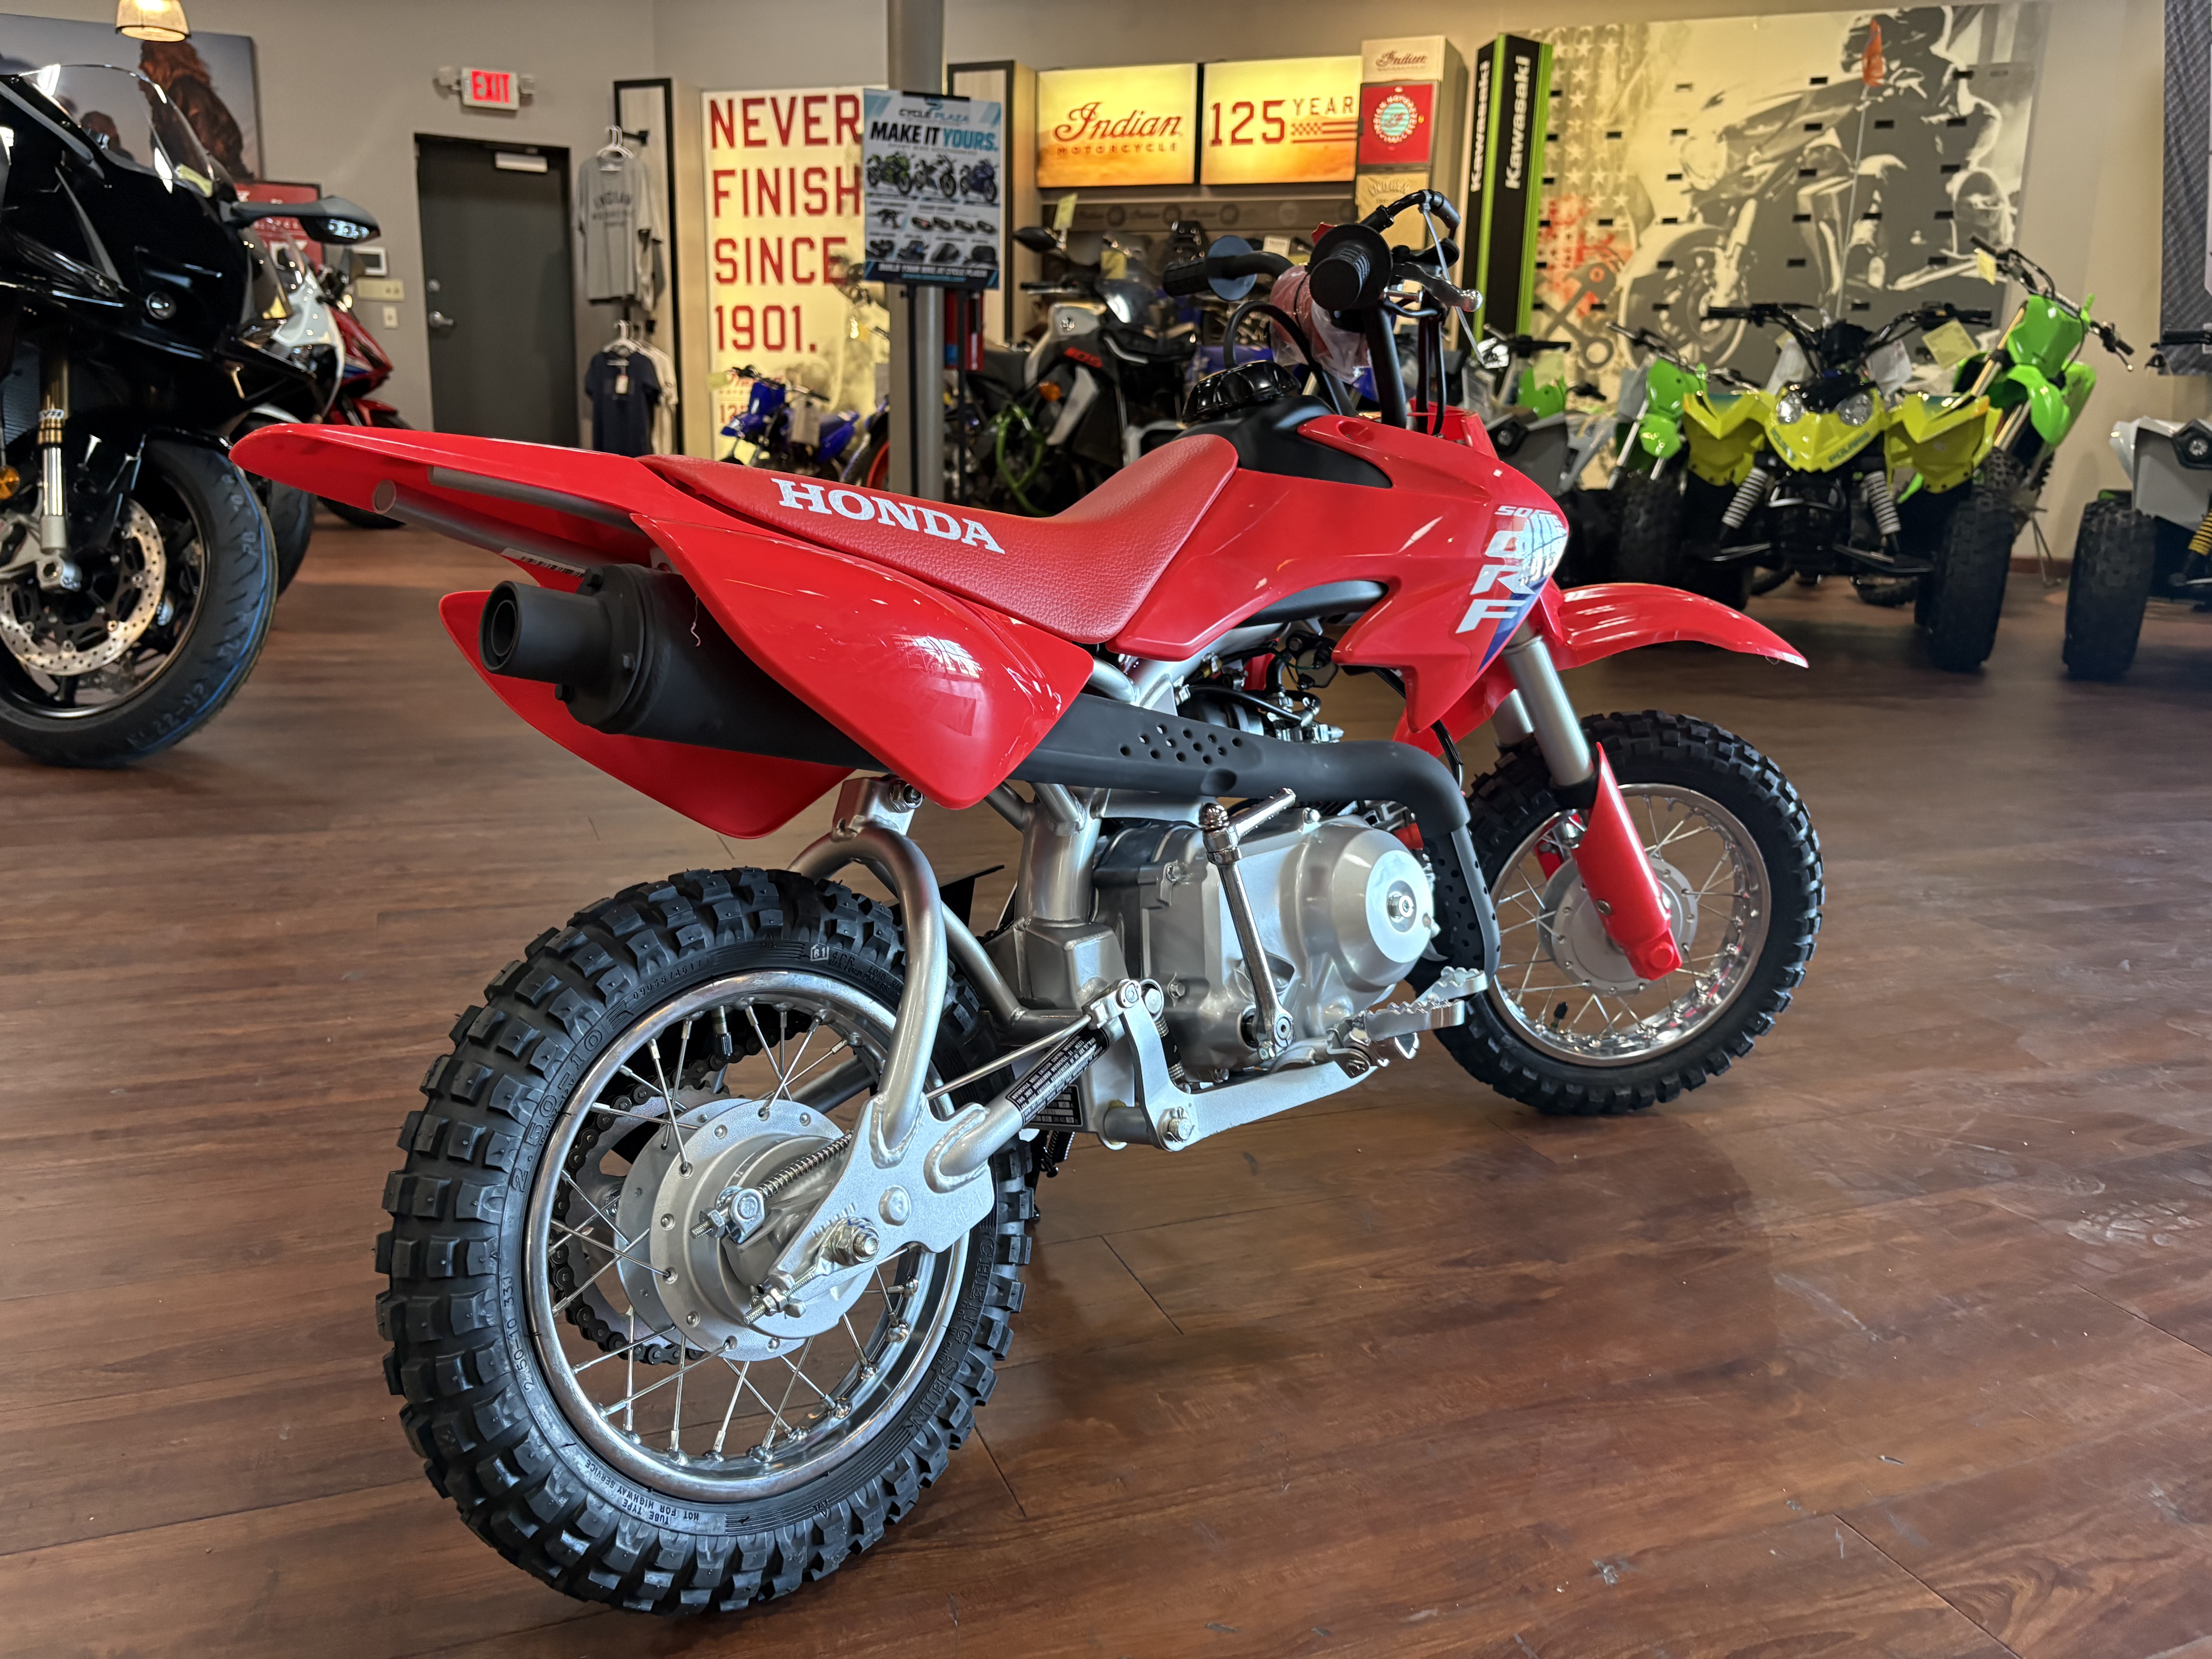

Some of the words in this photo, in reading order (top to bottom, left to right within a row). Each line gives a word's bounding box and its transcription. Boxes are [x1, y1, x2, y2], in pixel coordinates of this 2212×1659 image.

[471, 70, 511, 104] EXIT
[710, 94, 861, 149] NEVER
[898, 108, 931, 118] CYCLE
[1054, 101, 1183, 143] Indian
[1210, 100, 1286, 147] 125
[1293, 96, 1354, 116] YEAR
[1470, 59, 1491, 193] Kawasaki
[1506, 55, 1531, 189] Kawasaki
[870, 122, 923, 144] MAKE
[924, 126, 940, 145] IT
[943, 128, 999, 152] YOURS.
[1057, 142, 1178, 156] MOTORCYCLE
[715, 237, 848, 286] SINCE
[715, 305, 817, 352] 1901.
[771, 478, 1006, 555] HONDA
[511, 1030, 603, 1193] 2.50-10
[957, 1237, 995, 1345] CHENG
[907, 1356, 959, 1430] SHIN
[585, 1461, 616, 1487] SERVICE
[617, 1485, 654, 1510] HIGHWAY
[622, 1497, 642, 1515] TYPE
[648, 1511, 672, 1525] TUBE
[659, 1504, 677, 1517] FOR
[683, 1511, 699, 1522] NOT
